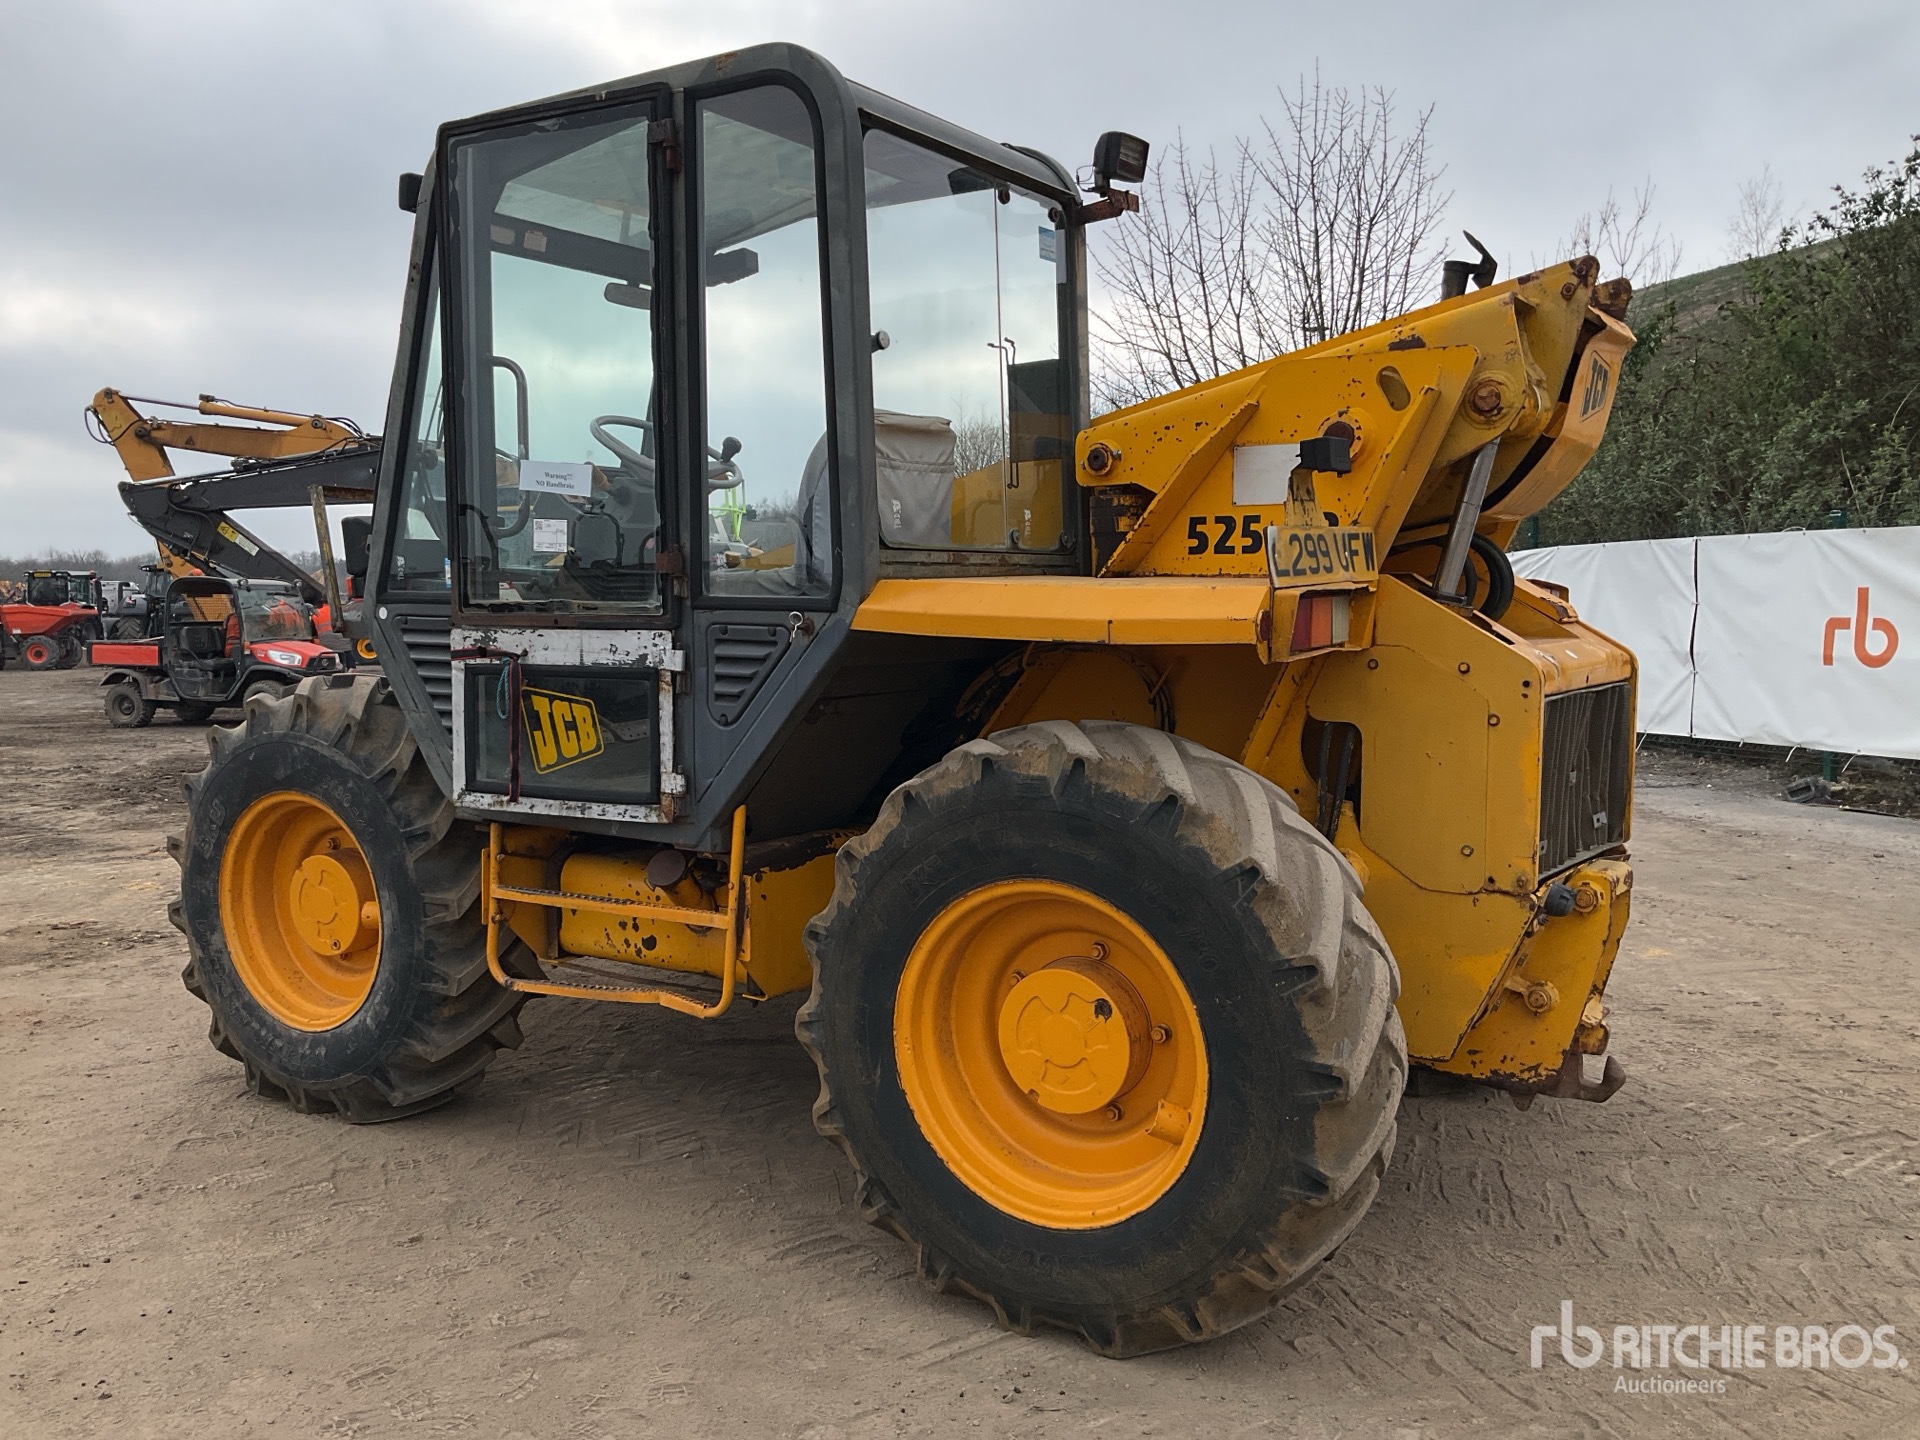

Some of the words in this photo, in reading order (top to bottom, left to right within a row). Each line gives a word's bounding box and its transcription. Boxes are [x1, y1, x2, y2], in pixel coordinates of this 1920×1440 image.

[1581, 358, 1609, 417] JCB
[535, 479, 545, 488] NO
[546, 480, 575, 490] Handbrake
[1822, 586, 1899, 669] rb
[531, 694, 598, 768] JCB
